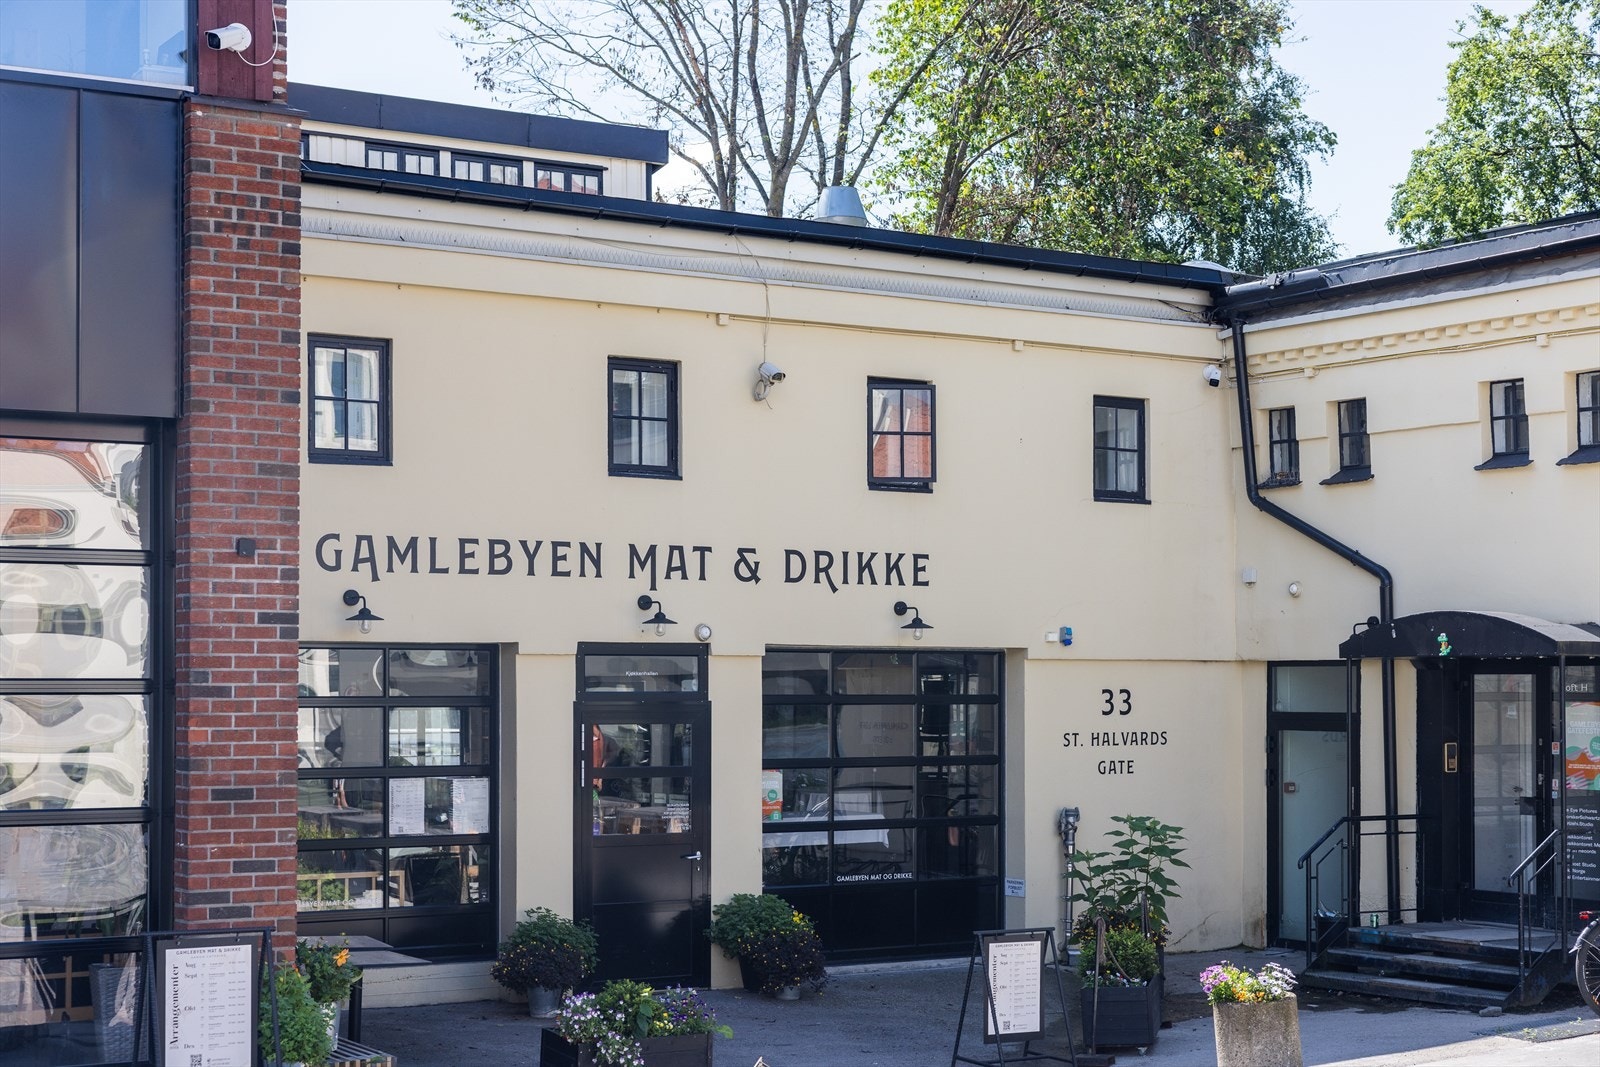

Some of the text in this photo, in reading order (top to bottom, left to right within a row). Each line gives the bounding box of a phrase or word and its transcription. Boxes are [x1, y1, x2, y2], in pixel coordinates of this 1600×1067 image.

[315, 533, 930, 594] GAMLEBYEN MAT & DRIKKE
[1101, 688, 1132, 716] 33
[1063, 731, 1168, 747] ST. HALVARDS
[1097, 760, 1135, 775] GATE
[836, 873, 869, 882] GAMLEBYEN
[882, 872, 893, 880] OG
[894, 871, 914, 879] DRIKKE
[169, 963, 181, 1045] Arrangementer
